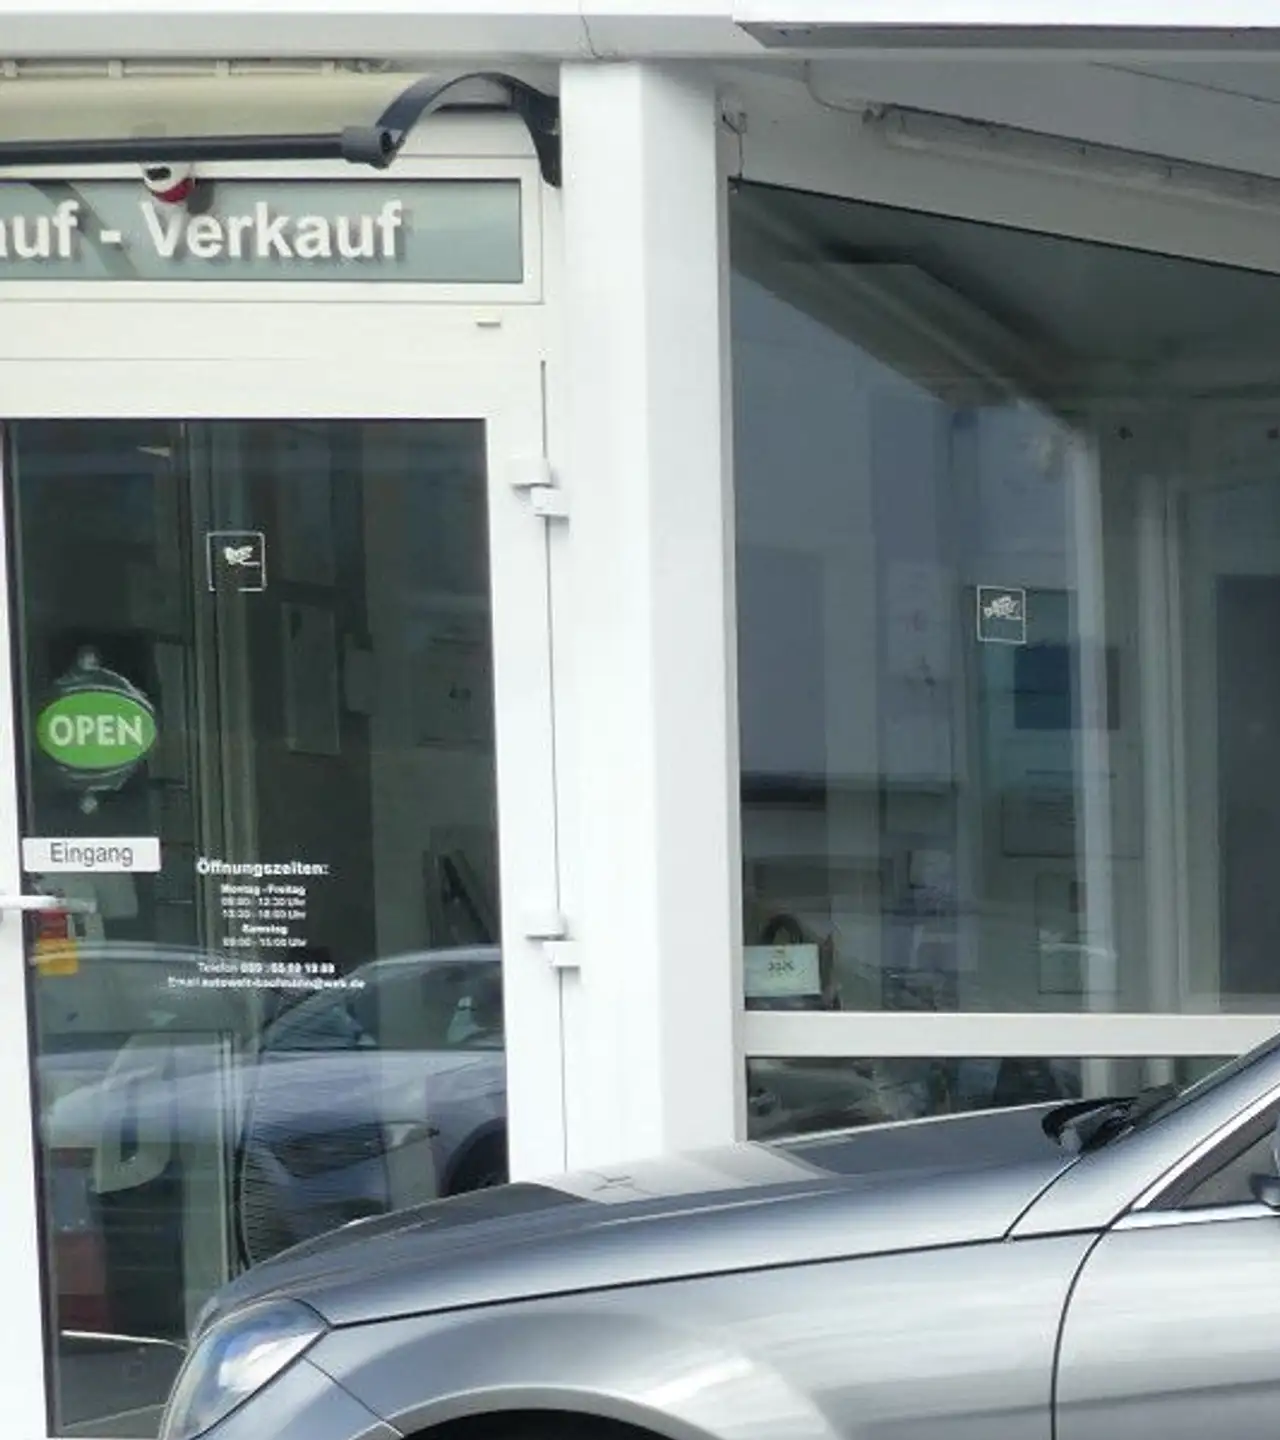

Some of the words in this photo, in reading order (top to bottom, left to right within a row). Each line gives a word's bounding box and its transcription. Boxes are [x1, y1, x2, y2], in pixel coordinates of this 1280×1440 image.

[100, 230, 122, 244] -
[141, 199, 402, 258] Verkauf
[50, 714, 143, 746] OPEN
[50, 842, 133, 867] Eingang
